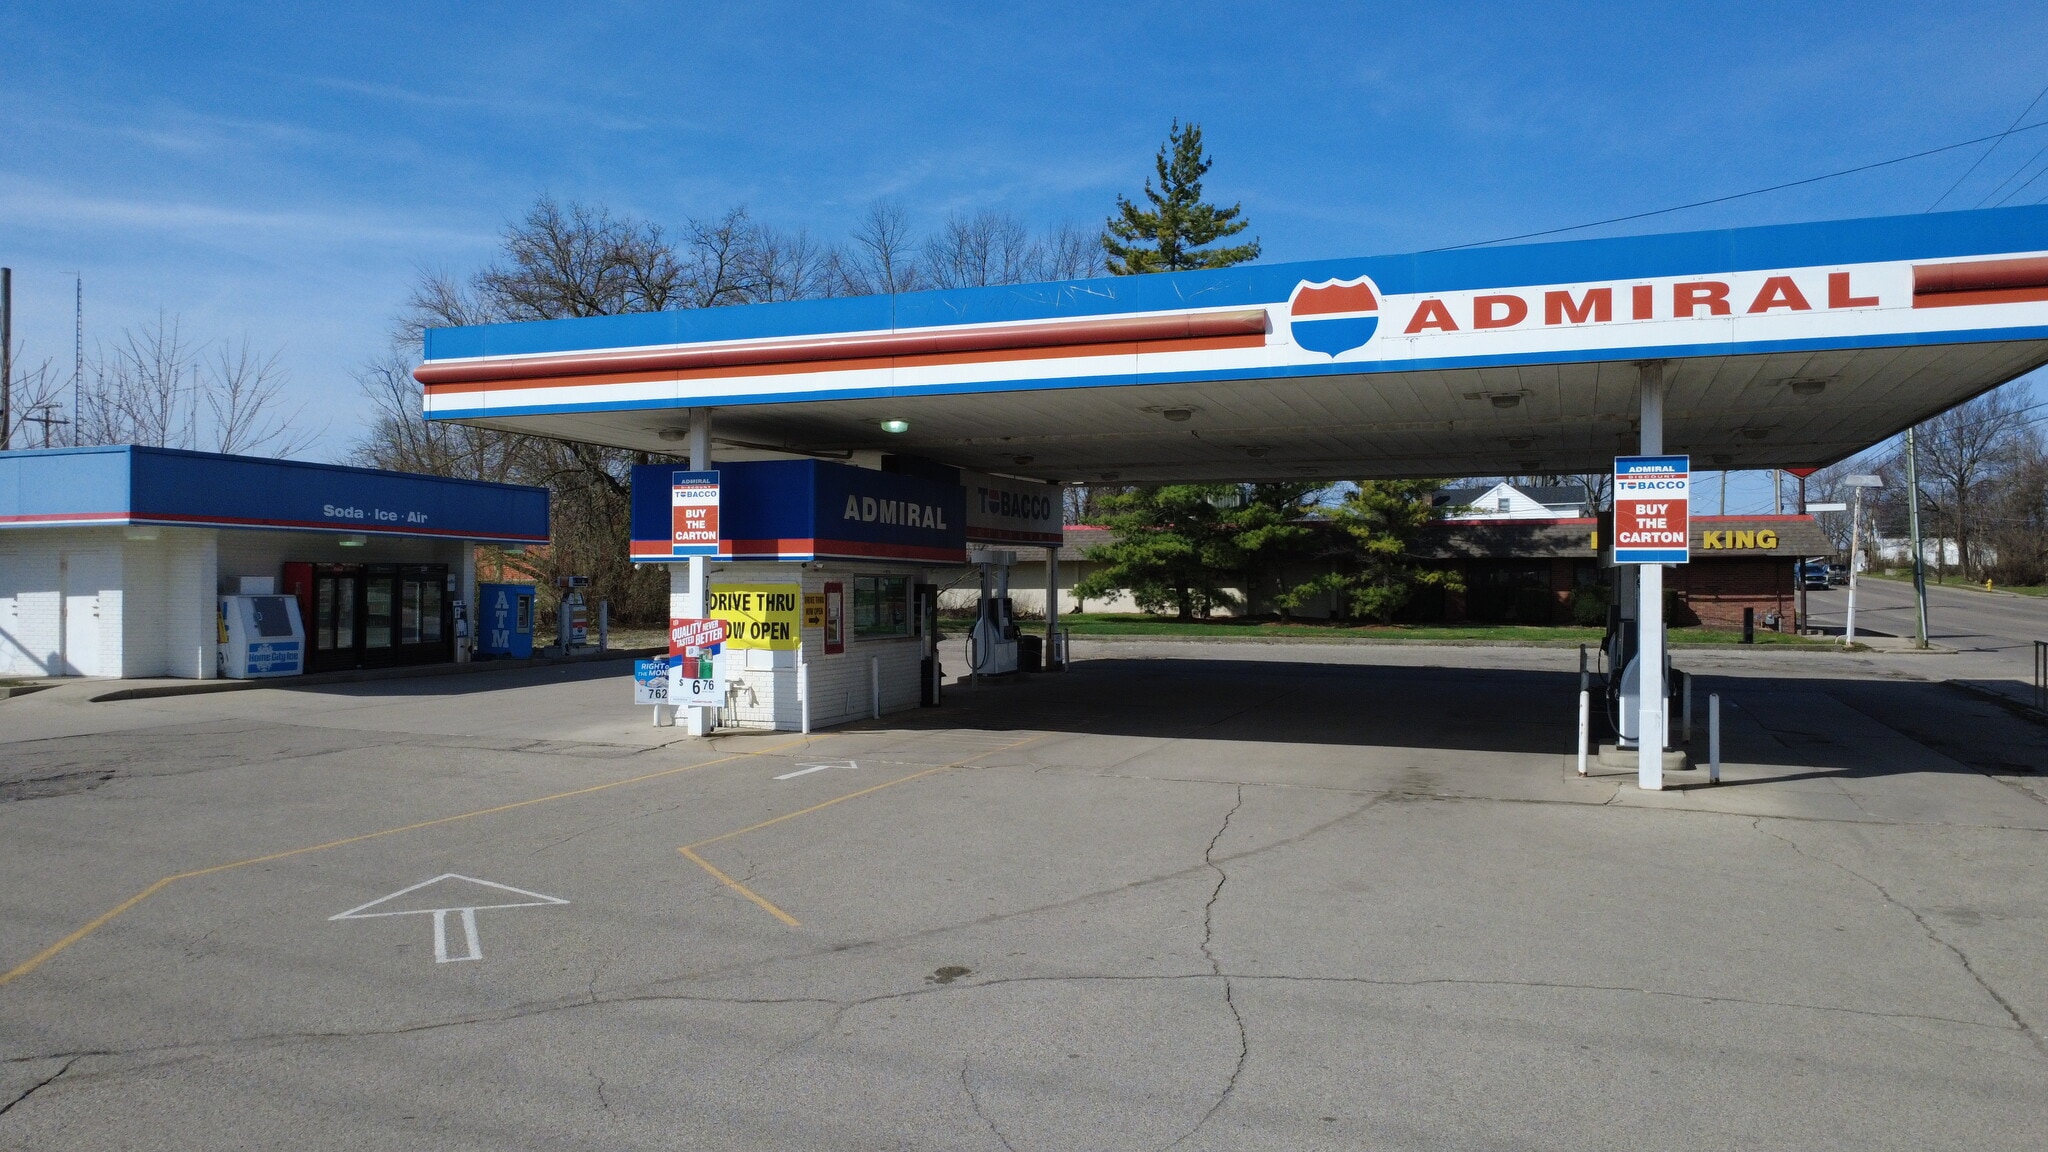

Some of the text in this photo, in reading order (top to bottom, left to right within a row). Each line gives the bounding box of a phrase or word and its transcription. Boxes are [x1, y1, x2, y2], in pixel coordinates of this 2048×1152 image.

[1403, 272, 1879, 334] ADMIRAL
[1628, 465, 1675, 473] ADMIRAL
[323, 504, 428, 523] Soda Ice Air
[685, 509, 706, 518] BUY
[844, 494, 947, 530] ADMIRAL
[1635, 504, 1668, 515] BUY
[686, 520, 706, 529] THE
[1636, 518, 1667, 529] THE
[675, 531, 716, 540] CARTON
[1619, 531, 1684, 543] CARTON
[1703, 529, 1777, 549] KING
[710, 593, 795, 611] DRIVE THRU
[492, 590, 510, 648] ATM
[672, 621, 702, 642] QUALITY
[702, 620, 719, 631] NEVER
[695, 627, 723, 646] BETTER
[726, 621, 790, 639] OW OPEN
[249, 651, 298, 663] Home City Ice
